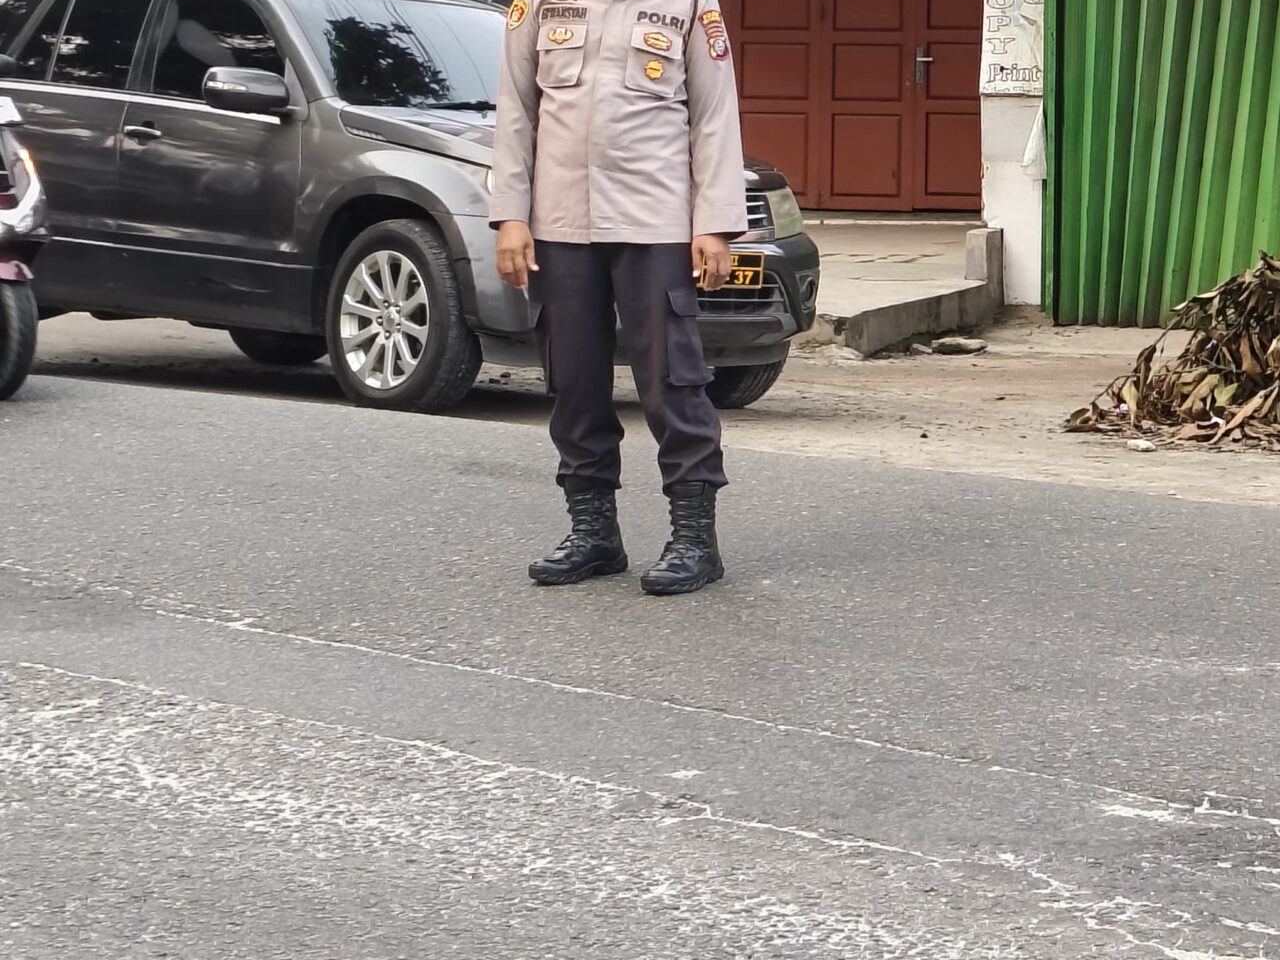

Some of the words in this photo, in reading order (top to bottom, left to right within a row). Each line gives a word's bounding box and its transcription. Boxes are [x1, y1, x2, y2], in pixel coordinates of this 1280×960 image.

[637, 10, 686, 31] POLRI
[986, 63, 1042, 83] Print
[734, 271, 753, 285] 37
